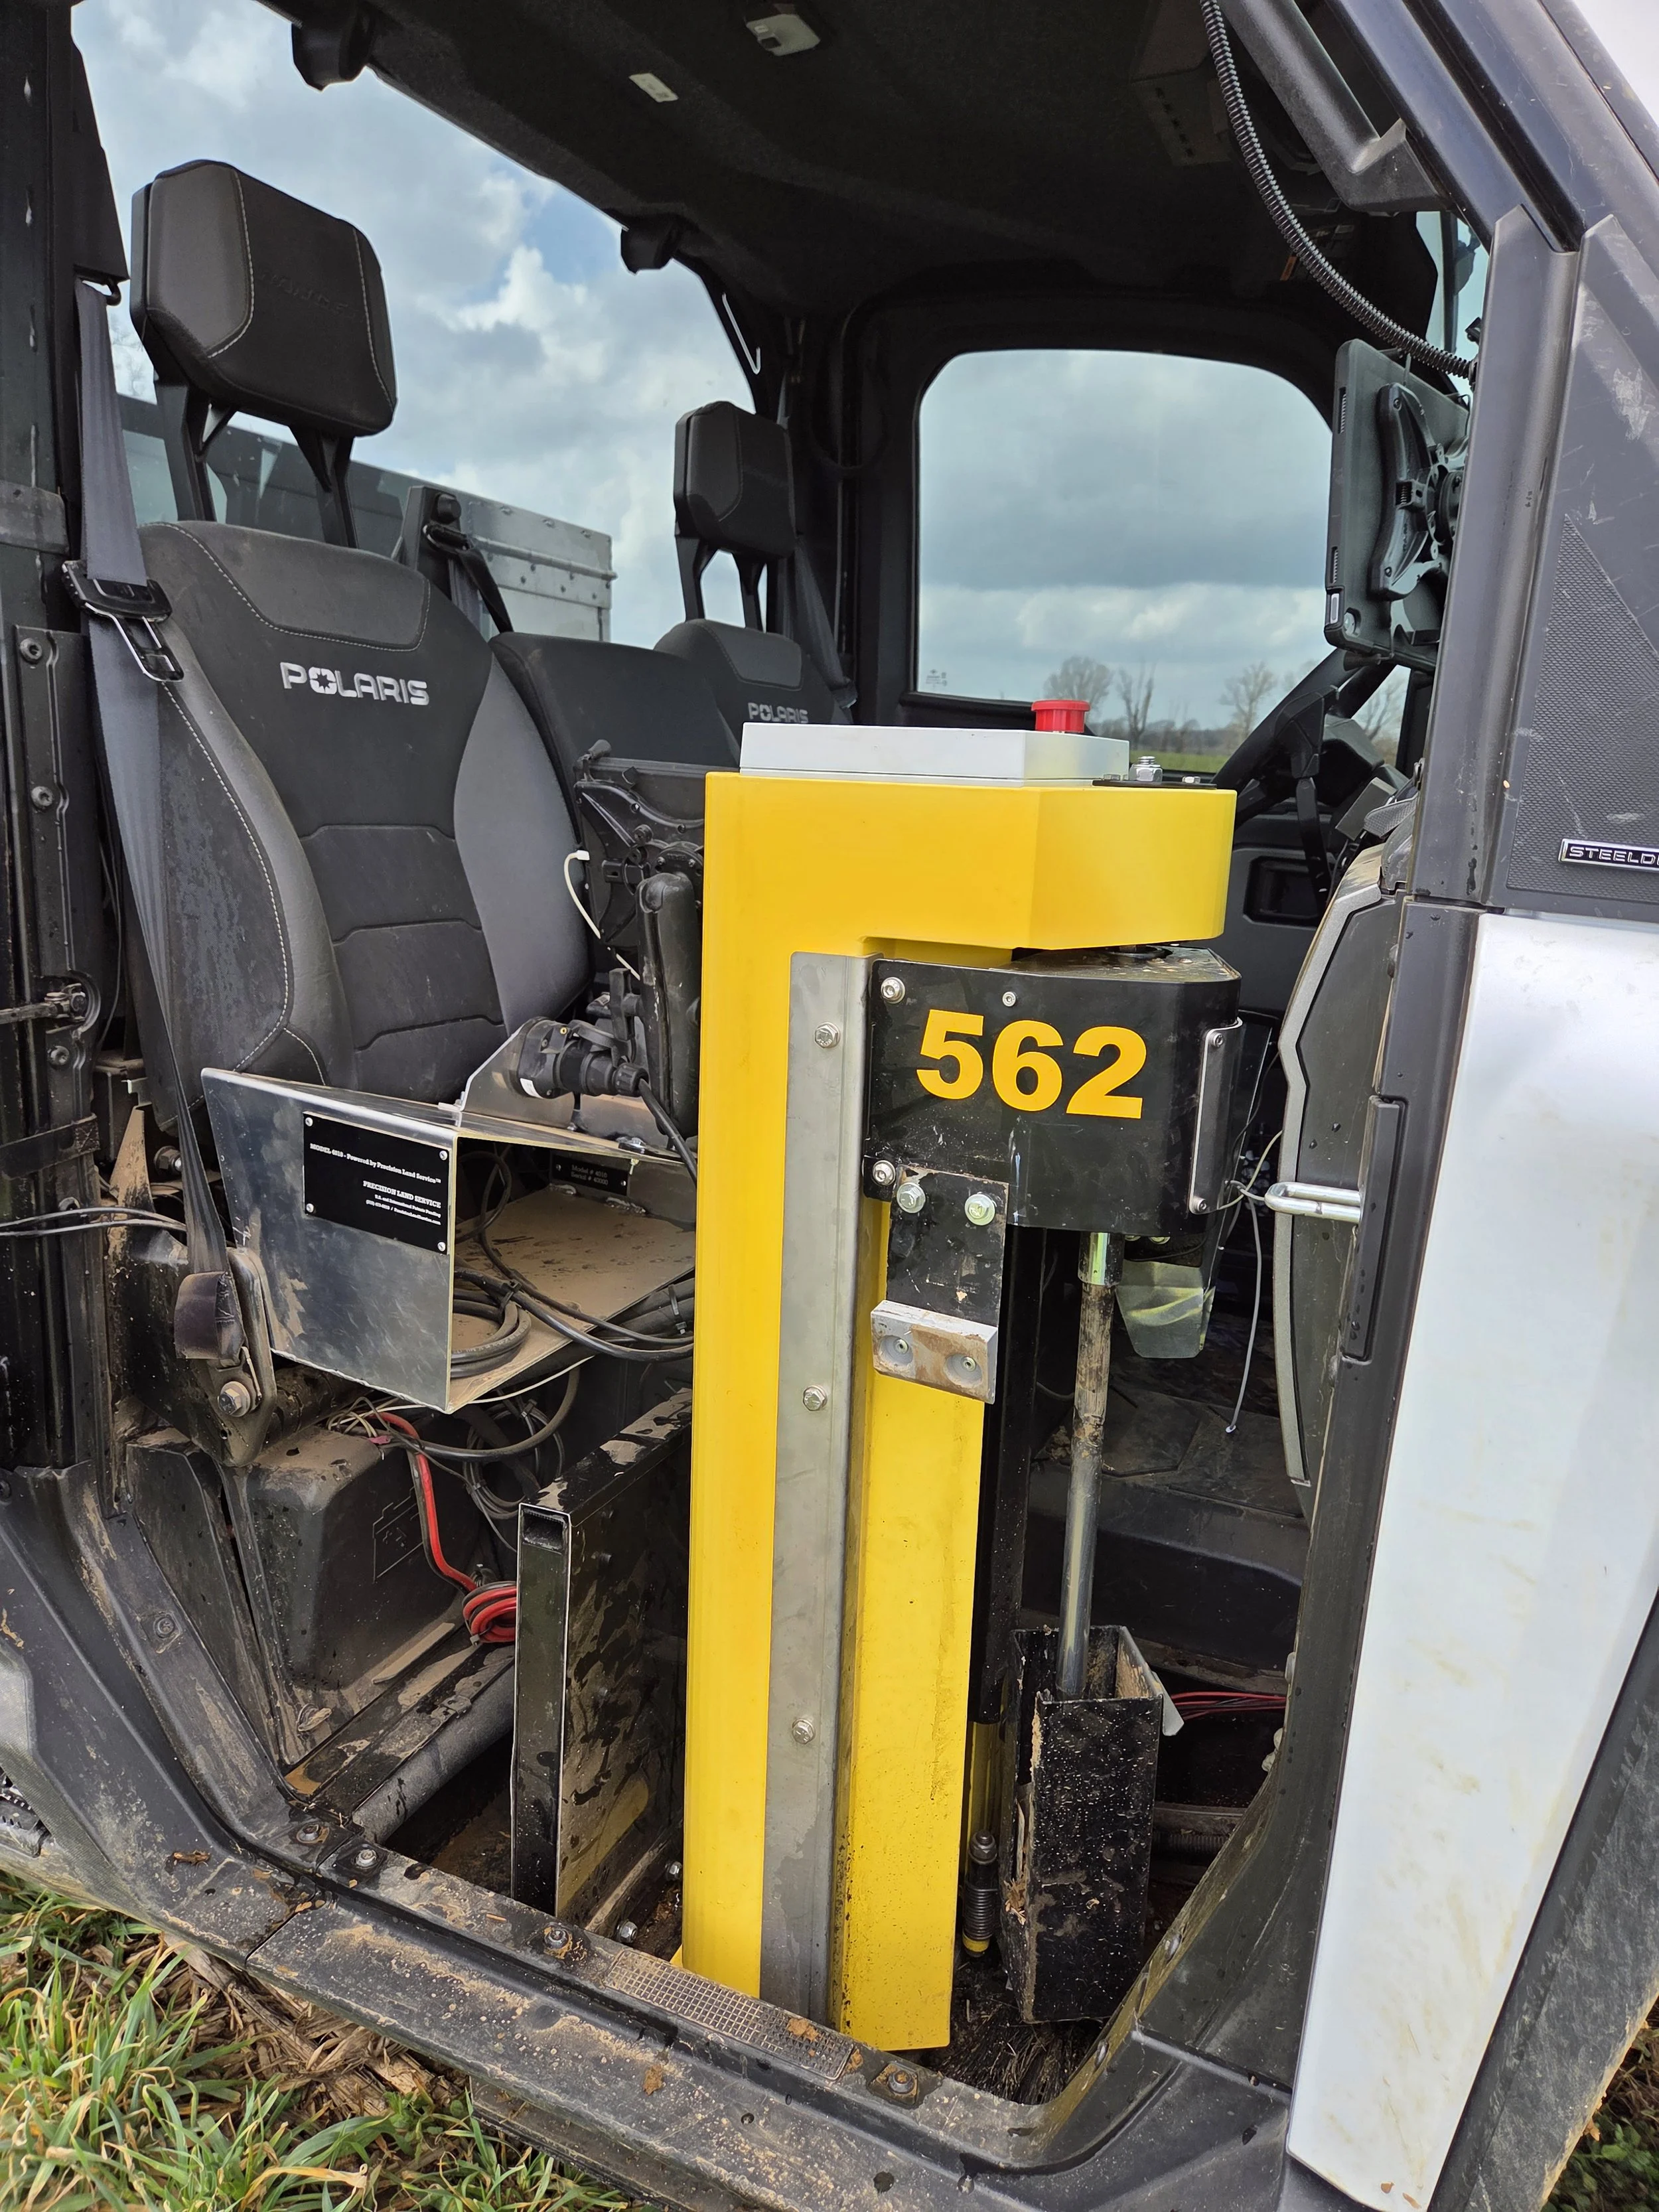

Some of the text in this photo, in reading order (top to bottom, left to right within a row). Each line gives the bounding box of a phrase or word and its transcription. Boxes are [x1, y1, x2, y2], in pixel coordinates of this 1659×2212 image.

[280, 662, 429, 705] POLARIS
[748, 702, 808, 723] POLARIS
[1569, 846, 1659, 865] STEELD
[916, 1009, 1147, 1119] 562
[310, 1143, 331, 1154] MODEL
[346, 1153, 369, 1165] Powered
[370, 1159, 376, 1168] by
[402, 1169, 415, 1178] Land
[363, 1180, 441, 1209] PRECISION LAND SERVICE
